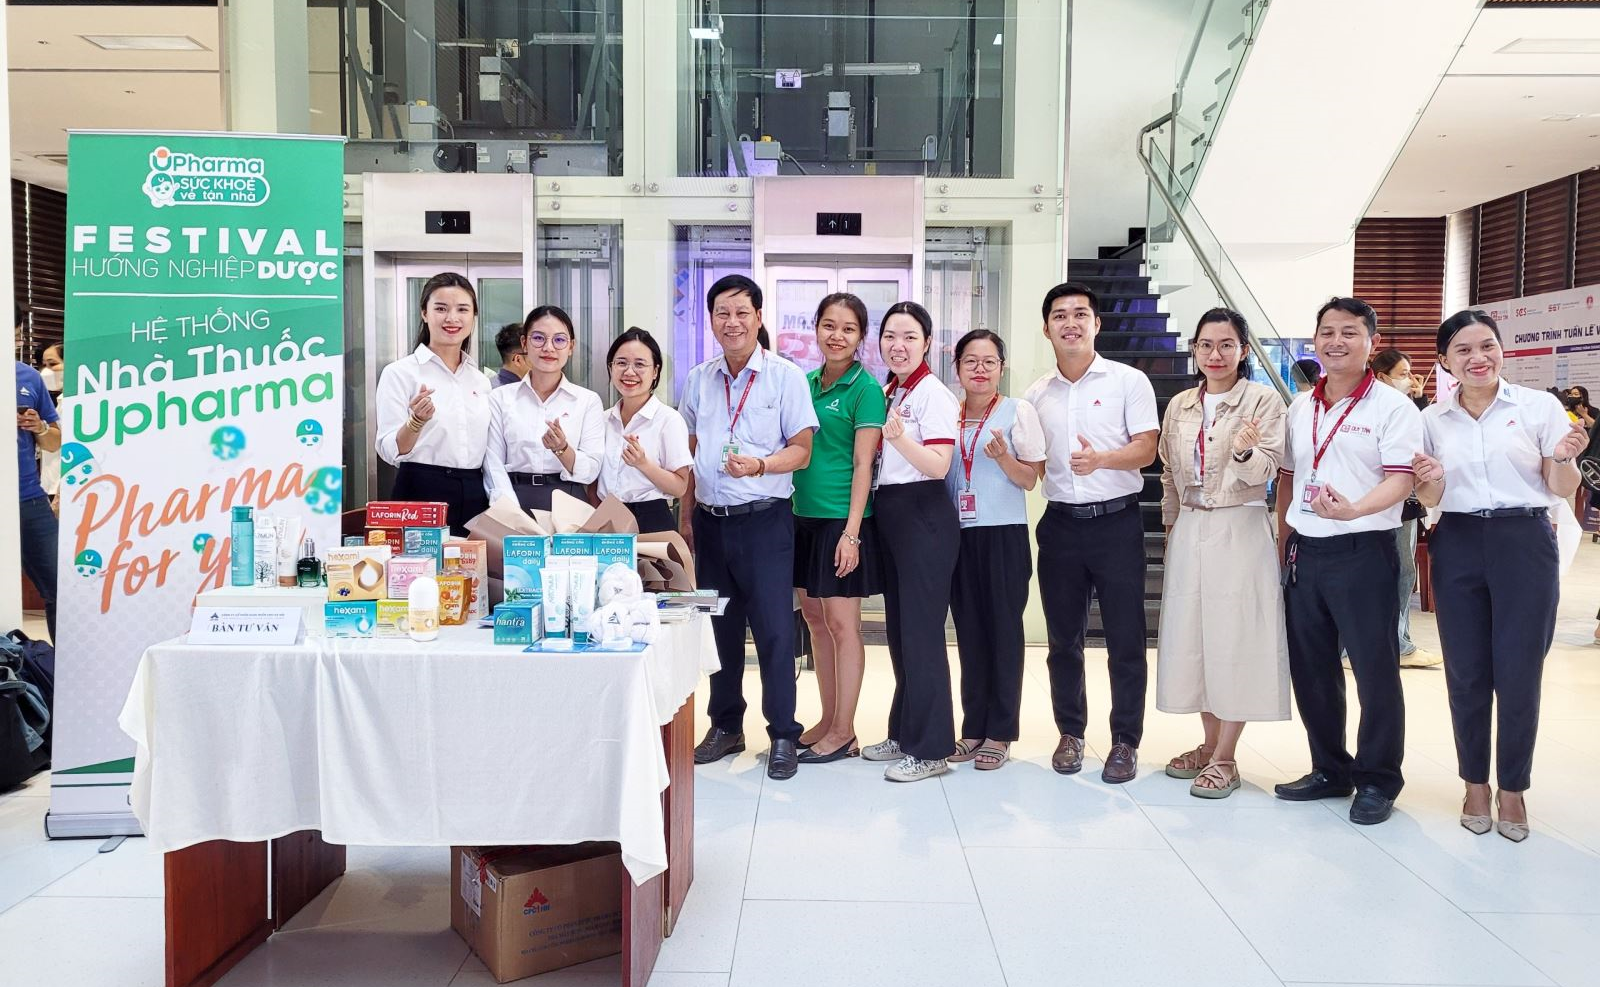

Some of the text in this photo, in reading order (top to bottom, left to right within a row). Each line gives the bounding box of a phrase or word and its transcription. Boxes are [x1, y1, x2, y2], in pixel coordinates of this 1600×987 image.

[453, 218, 457, 227] 1
[844, 220, 848, 229] 1
[73, 225, 338, 257] FESTIVAL
[72, 253, 338, 285] HƯỚNG NGHIỆP DƯỢC
[131, 306, 270, 343] HỆ THỐNG
[77, 327, 326, 396] Nhà Thuốc
[73, 371, 334, 446] Upharma
[71, 462, 320, 556] Pharma
[371, 511, 402, 519] LAFORIN
[401, 508, 419, 522] Red
[421, 546, 438, 554] daily
[506, 549, 541, 558] LAFORIN
[555, 547, 590, 555] LAFORIN
[595, 547, 630, 555] LAFORIN
[522, 557, 541, 566] daily
[611, 555, 630, 564] daily
[99, 540, 181, 614] for
[379, 604, 409, 613] hexam
